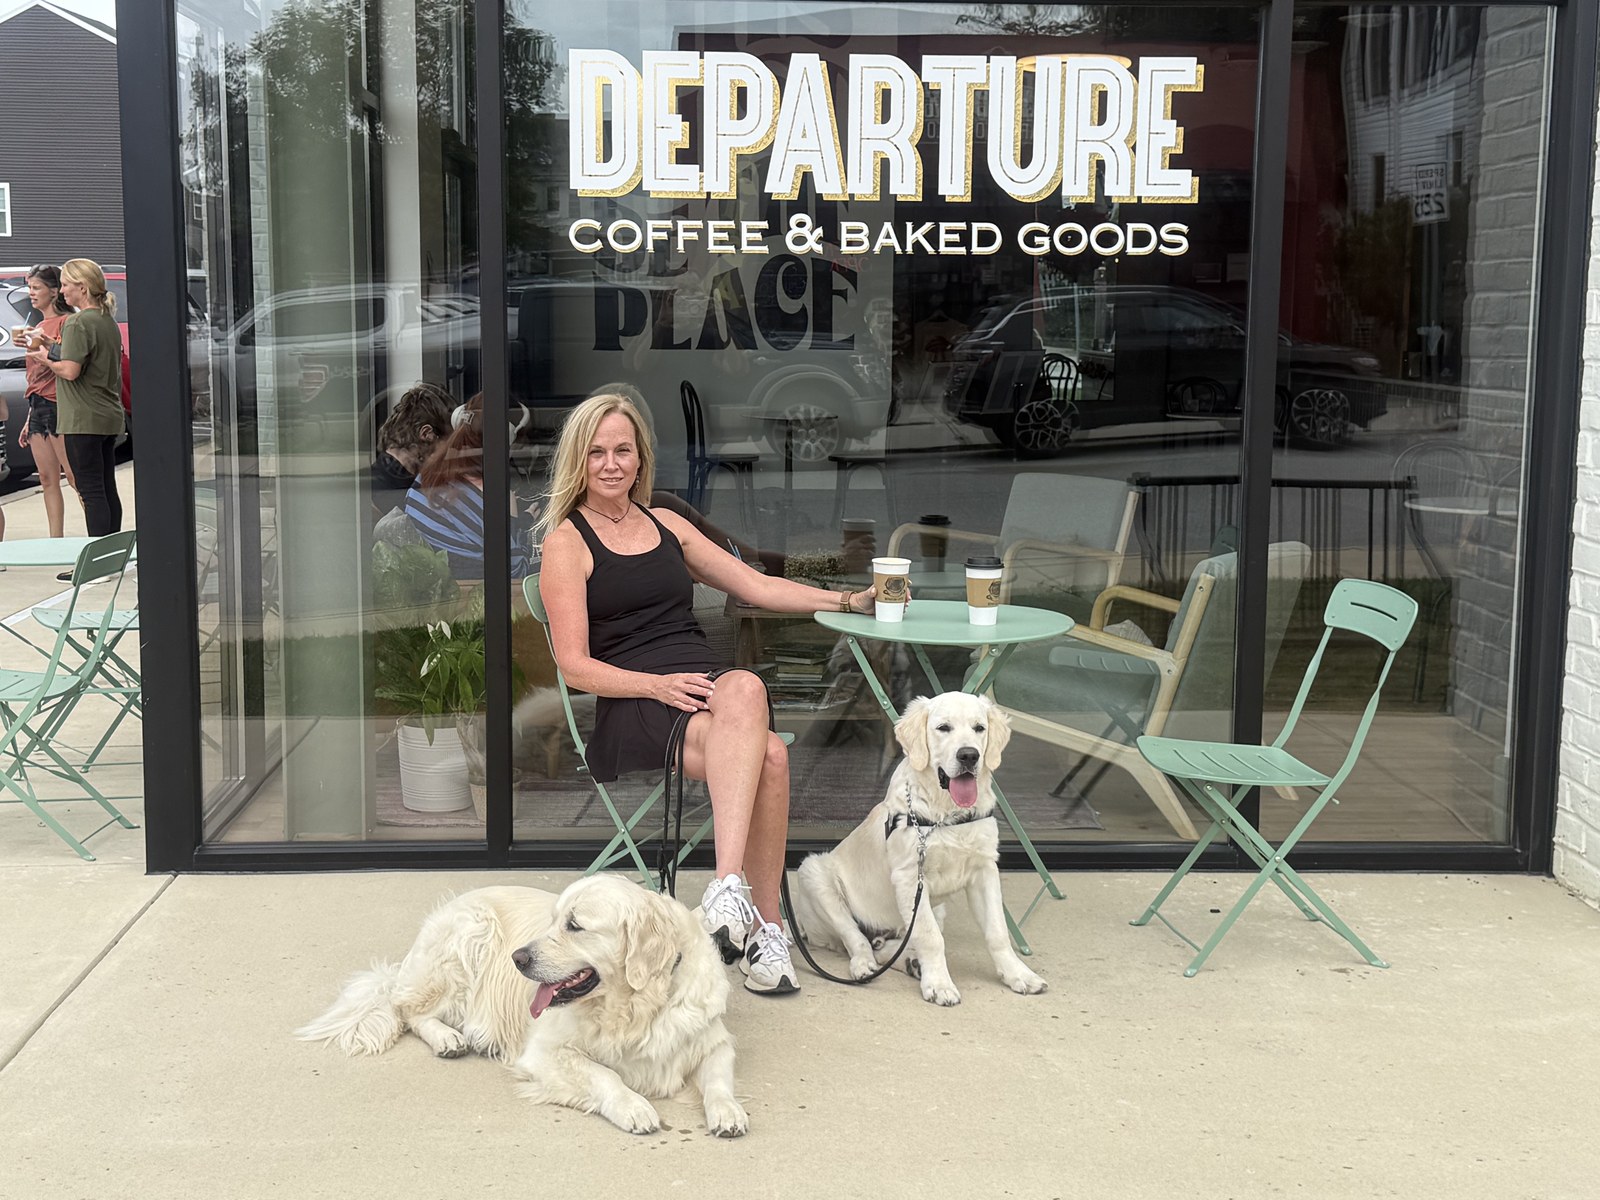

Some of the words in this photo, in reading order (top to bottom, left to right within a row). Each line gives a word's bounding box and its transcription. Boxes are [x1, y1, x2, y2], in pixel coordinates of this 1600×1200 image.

[568, 48, 1204, 204] DEPARTURE
[568, 218, 770, 254] COFFEE
[785, 212, 824, 254] &
[839, 220, 1003, 256] BAKED
[1017, 220, 1191, 257] GOODS
[592, 253, 858, 351] PLACE
